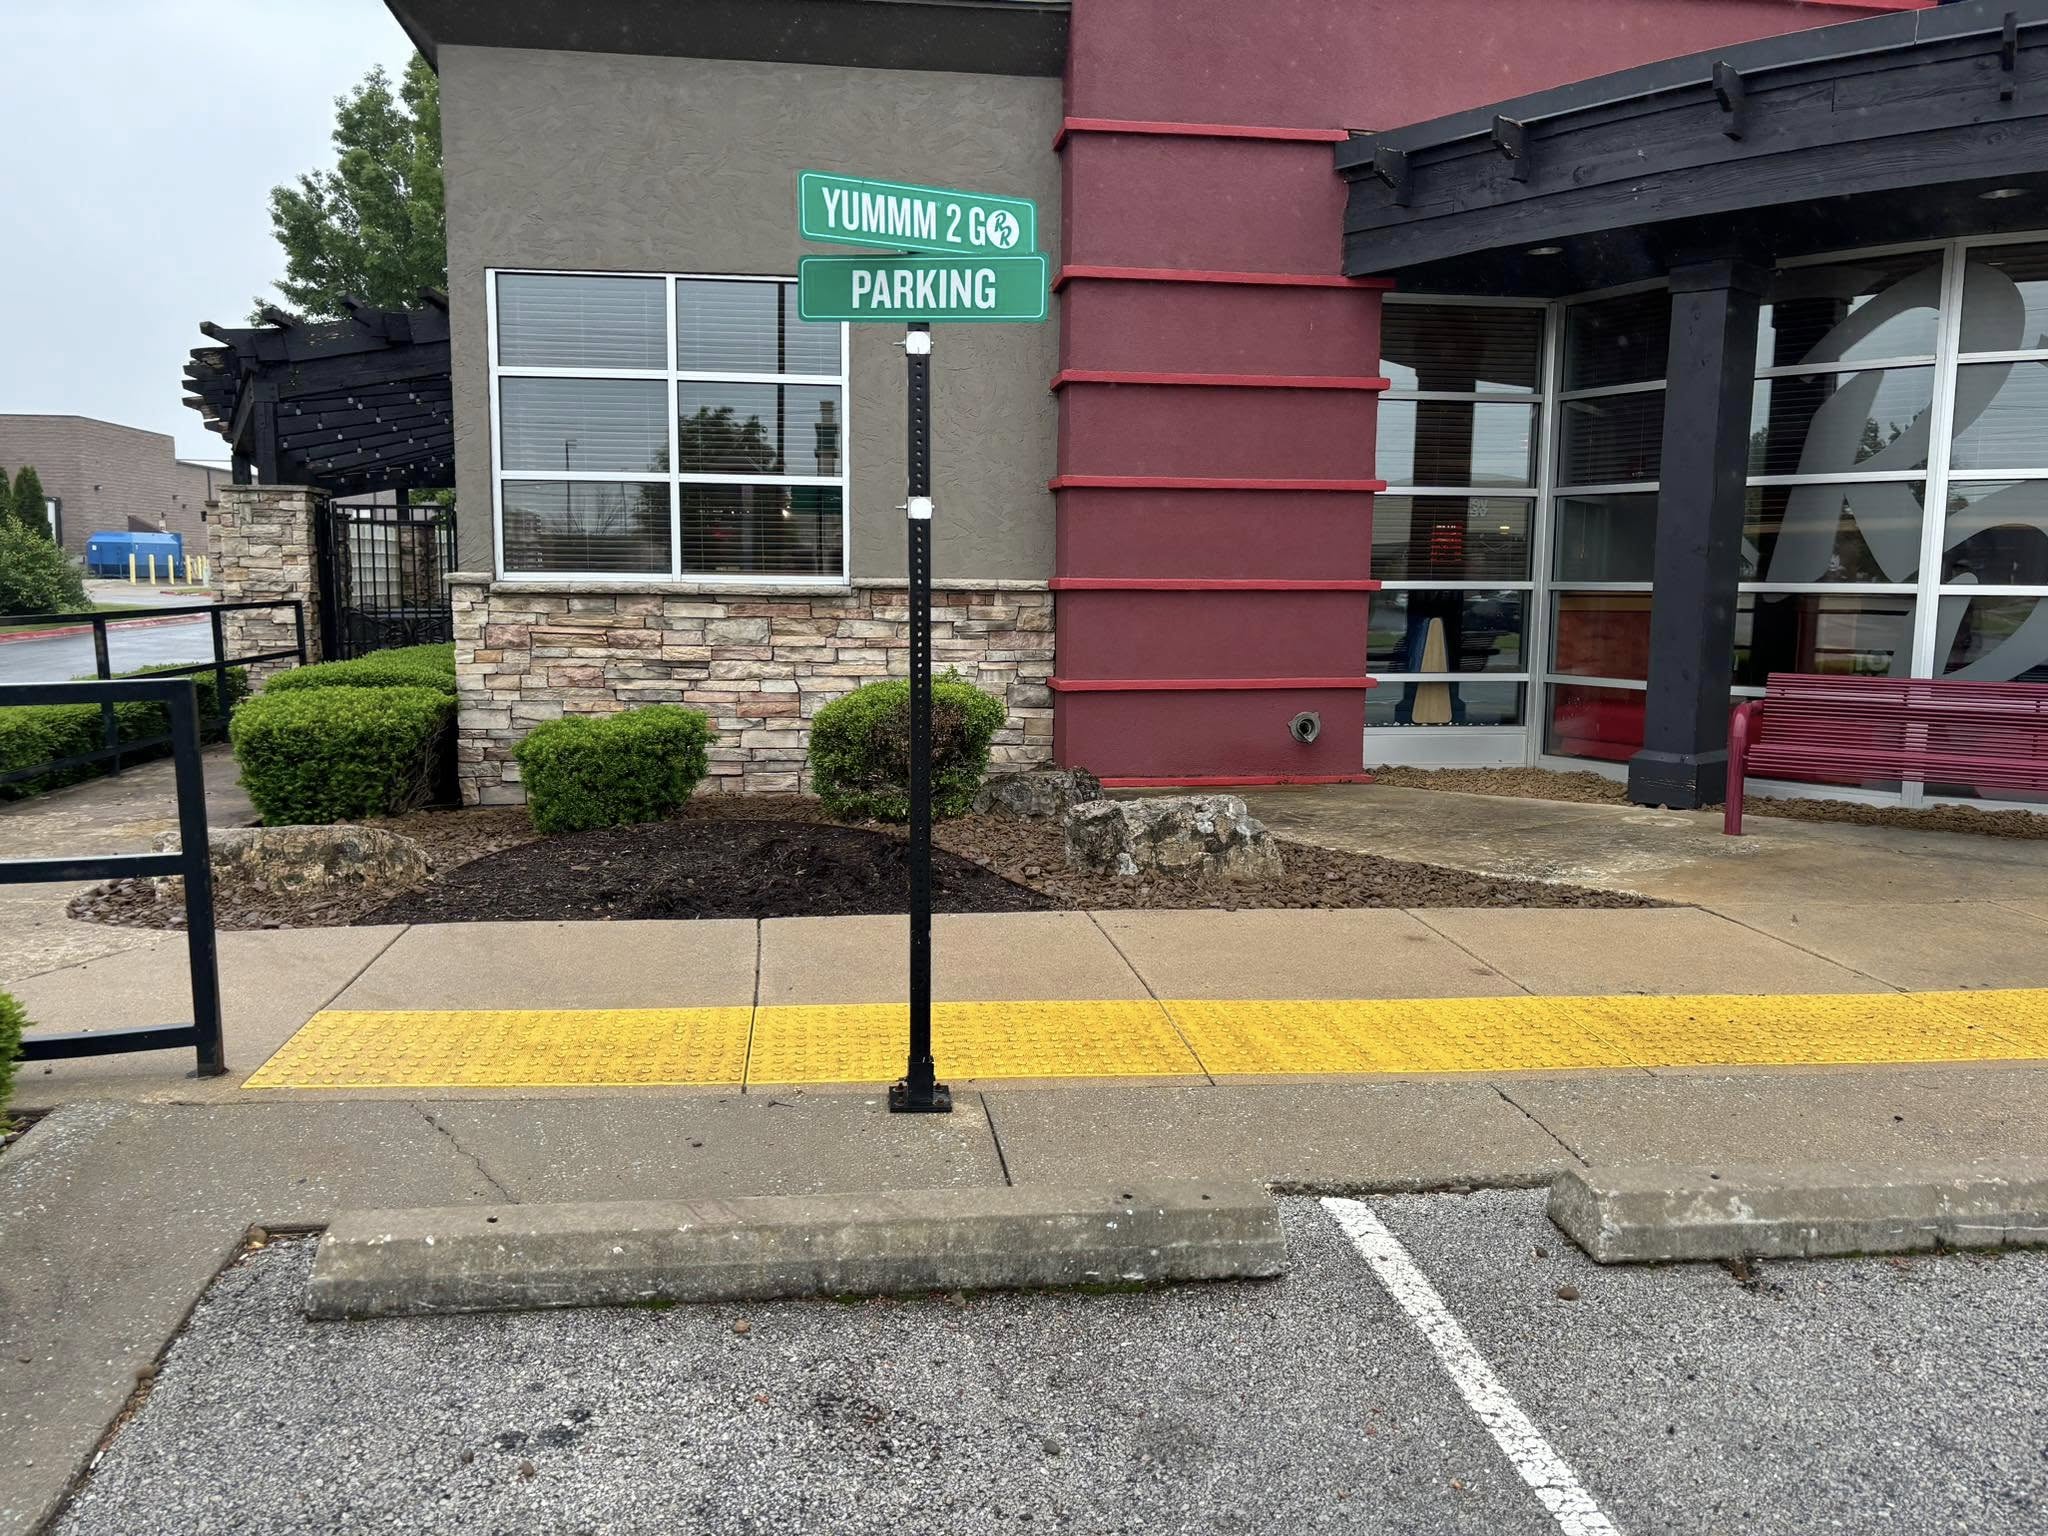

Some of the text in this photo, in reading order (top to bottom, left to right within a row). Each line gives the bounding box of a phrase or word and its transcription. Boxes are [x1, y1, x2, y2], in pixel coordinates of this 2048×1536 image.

[821, 186, 937, 240] YUMMM
[946, 203, 962, 243] 2
[851, 267, 996, 310] PARKING
